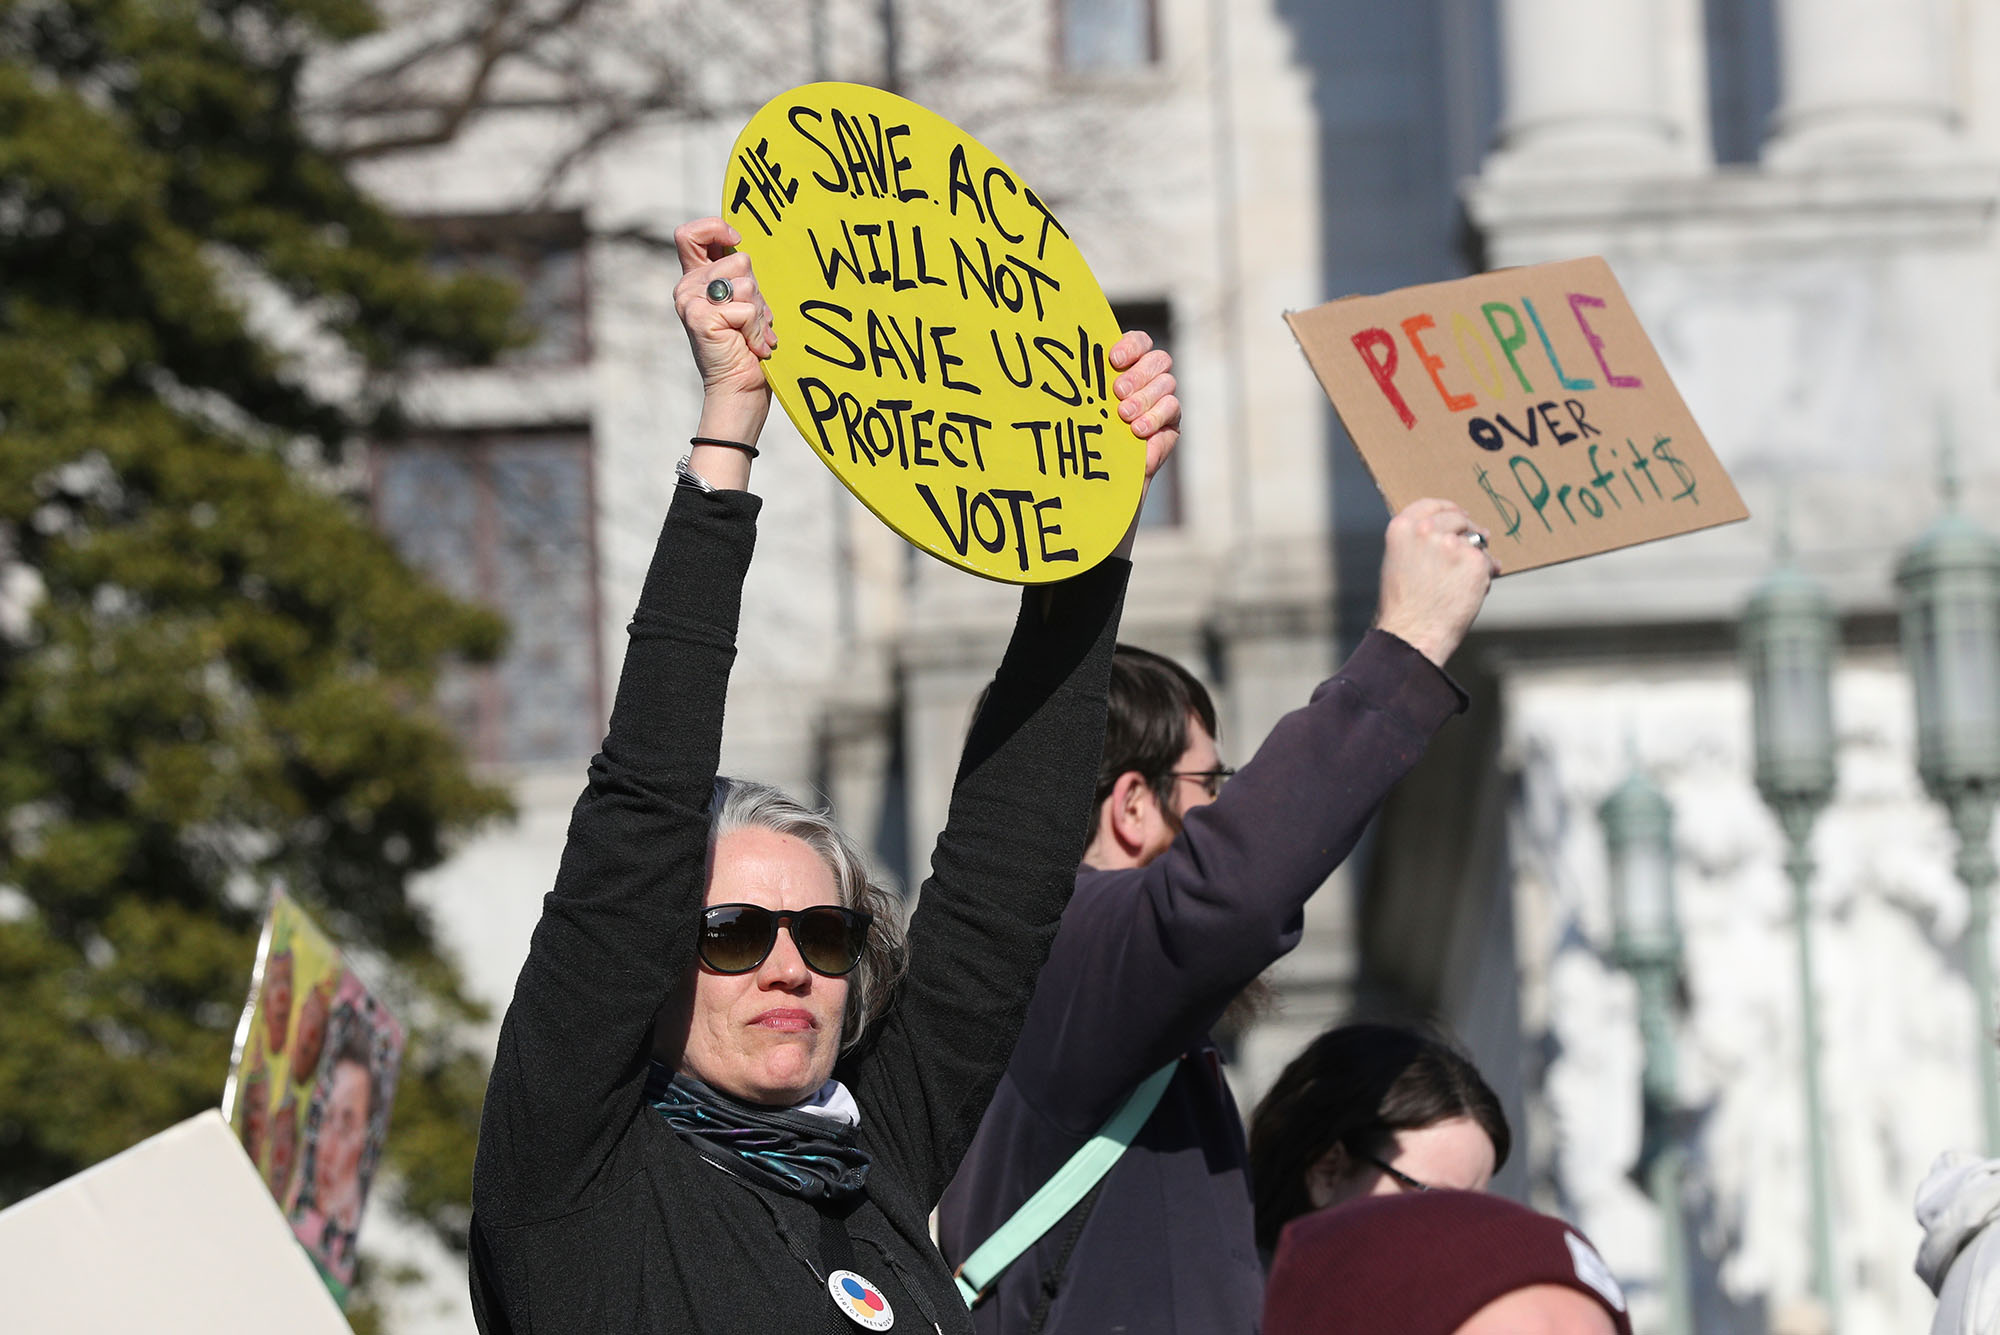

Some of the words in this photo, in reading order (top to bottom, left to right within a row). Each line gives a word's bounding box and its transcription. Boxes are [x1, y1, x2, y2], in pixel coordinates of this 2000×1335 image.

[731, 138, 799, 236] THE
[788, 106, 940, 205] S.A.V.E.
[949, 144, 1070, 260] ACT
[807, 220, 947, 292] WILL
[949, 238, 1060, 322] NOT
[799, 300, 982, 396] SAVE
[990, 325, 1109, 419] US!!
[1350, 292, 1645, 431] PEOPLE
[796, 378, 992, 472] PROTECT
[1010, 420, 1110, 482] THE
[1468, 399, 1602, 452] OVER
[914, 483, 1079, 572] VOTE
